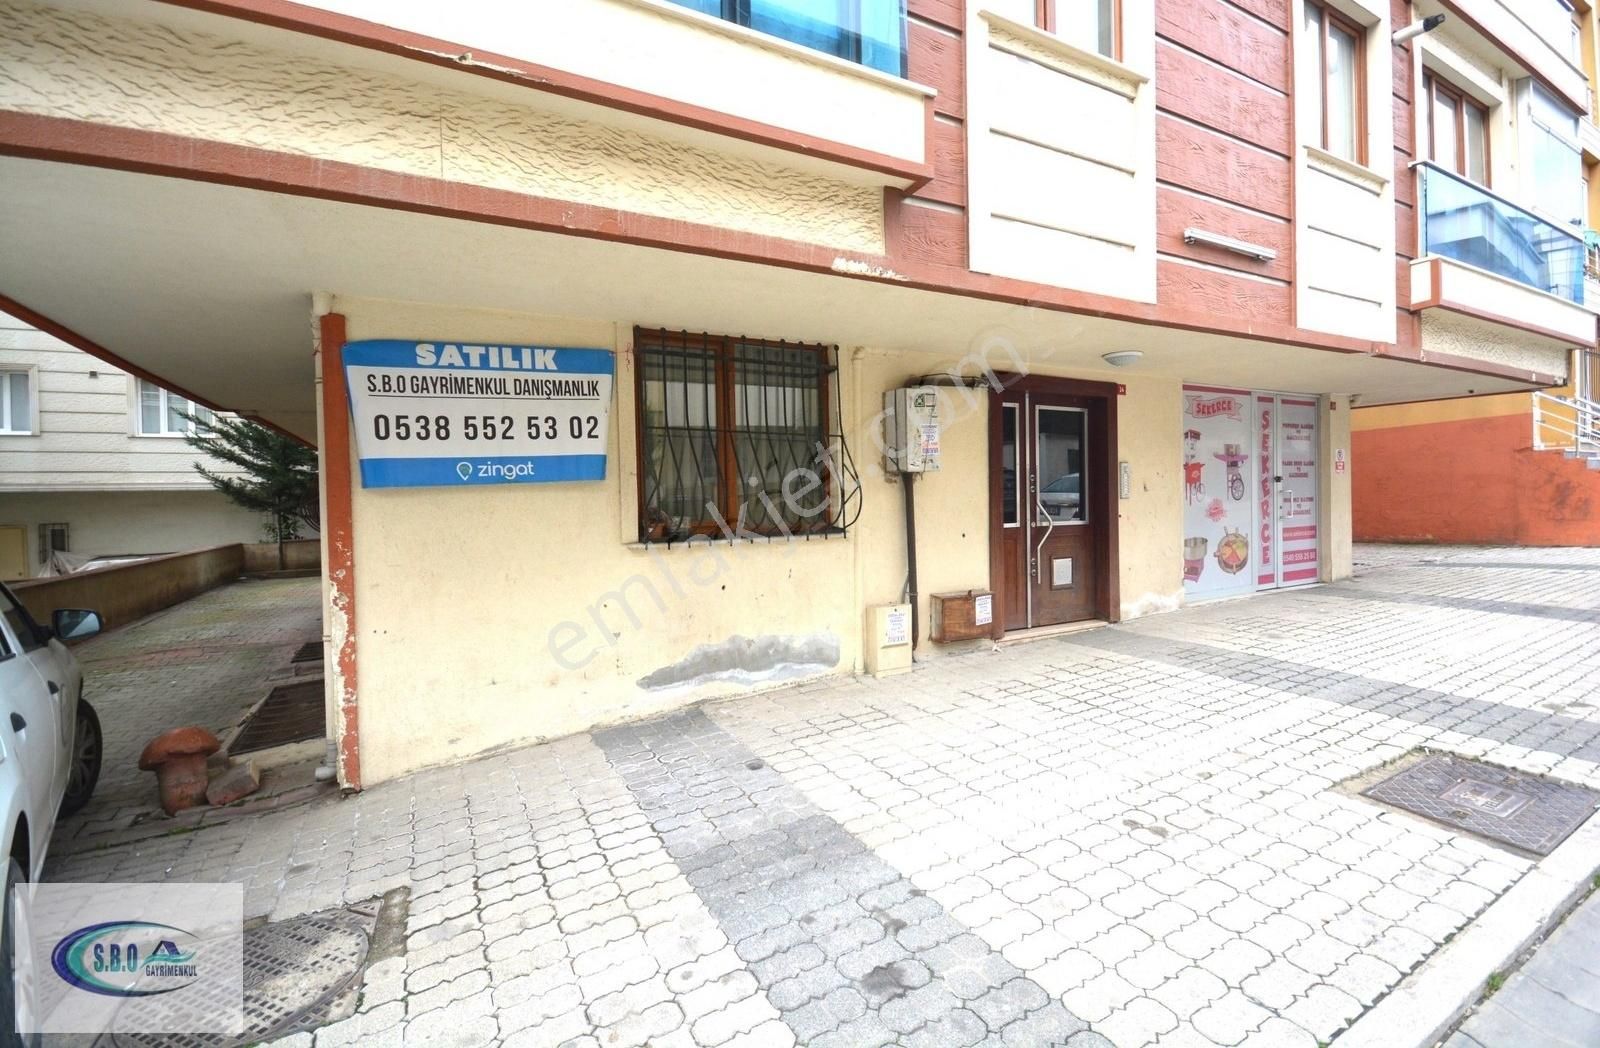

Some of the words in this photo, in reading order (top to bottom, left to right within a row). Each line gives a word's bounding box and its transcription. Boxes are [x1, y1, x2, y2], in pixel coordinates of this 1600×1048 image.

[415, 343, 559, 371] SATILIK
[367, 374, 406, 394] S.B.O
[410, 373, 511, 396] GAYRİMENKUL
[514, 378, 600, 399] DANIŞMANLIK
[374, 413, 451, 441] 0538
[463, 415, 515, 441] 552
[527, 415, 558, 440] 53
[569, 415, 600, 439] 02
[477, 461, 535, 480] zingat
